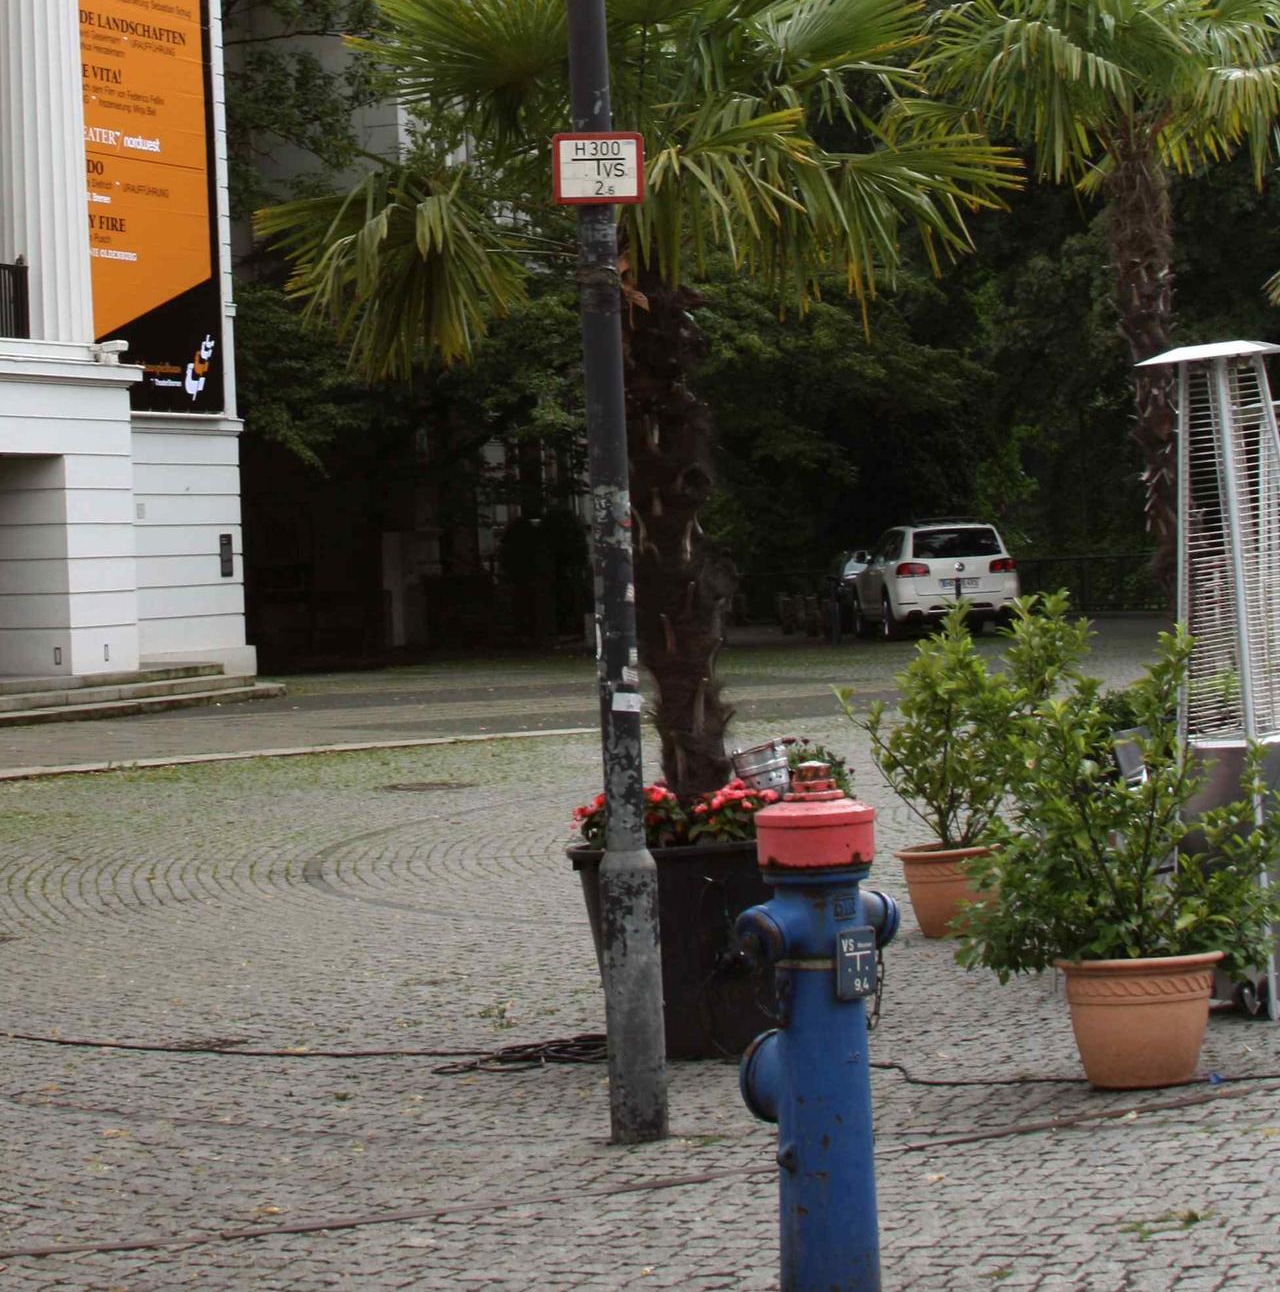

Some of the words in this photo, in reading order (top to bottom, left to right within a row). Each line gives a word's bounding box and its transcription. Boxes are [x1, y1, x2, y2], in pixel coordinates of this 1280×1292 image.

[97, 12, 187, 46] LANDSCHAFTEN
[91, 65, 122, 85] VITA!
[98, 214, 127, 233] FIRE
